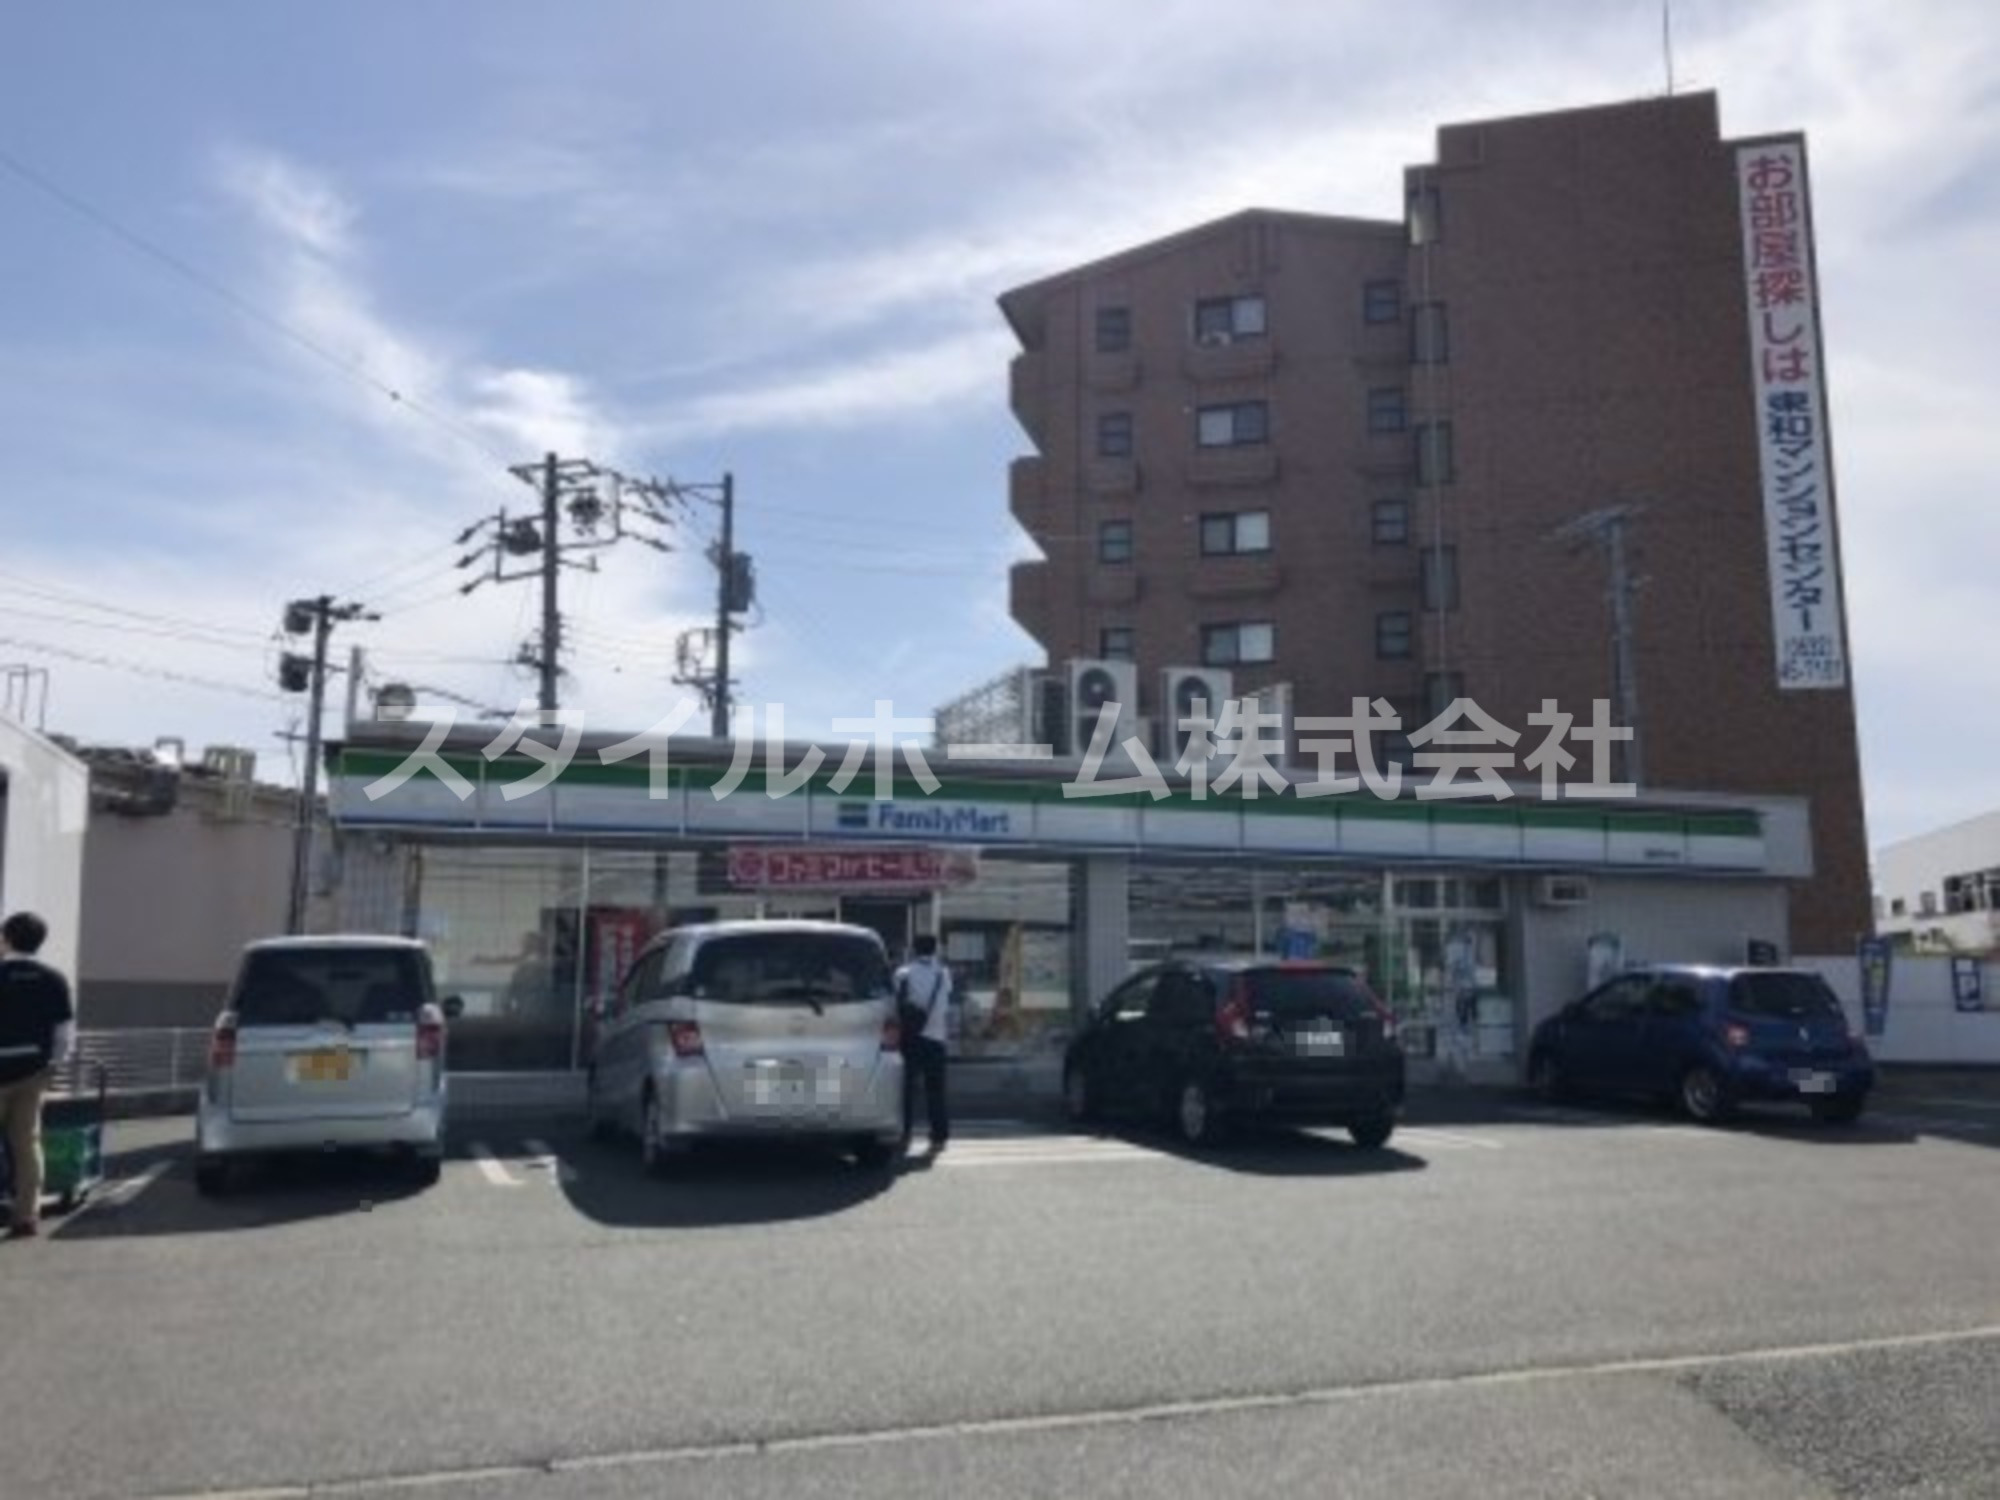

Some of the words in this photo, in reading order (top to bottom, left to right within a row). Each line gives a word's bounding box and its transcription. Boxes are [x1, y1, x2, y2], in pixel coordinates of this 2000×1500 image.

[1747, 154, 1810, 384] お部屋探しは
[879, 803, 1010, 833] FamilyMart
